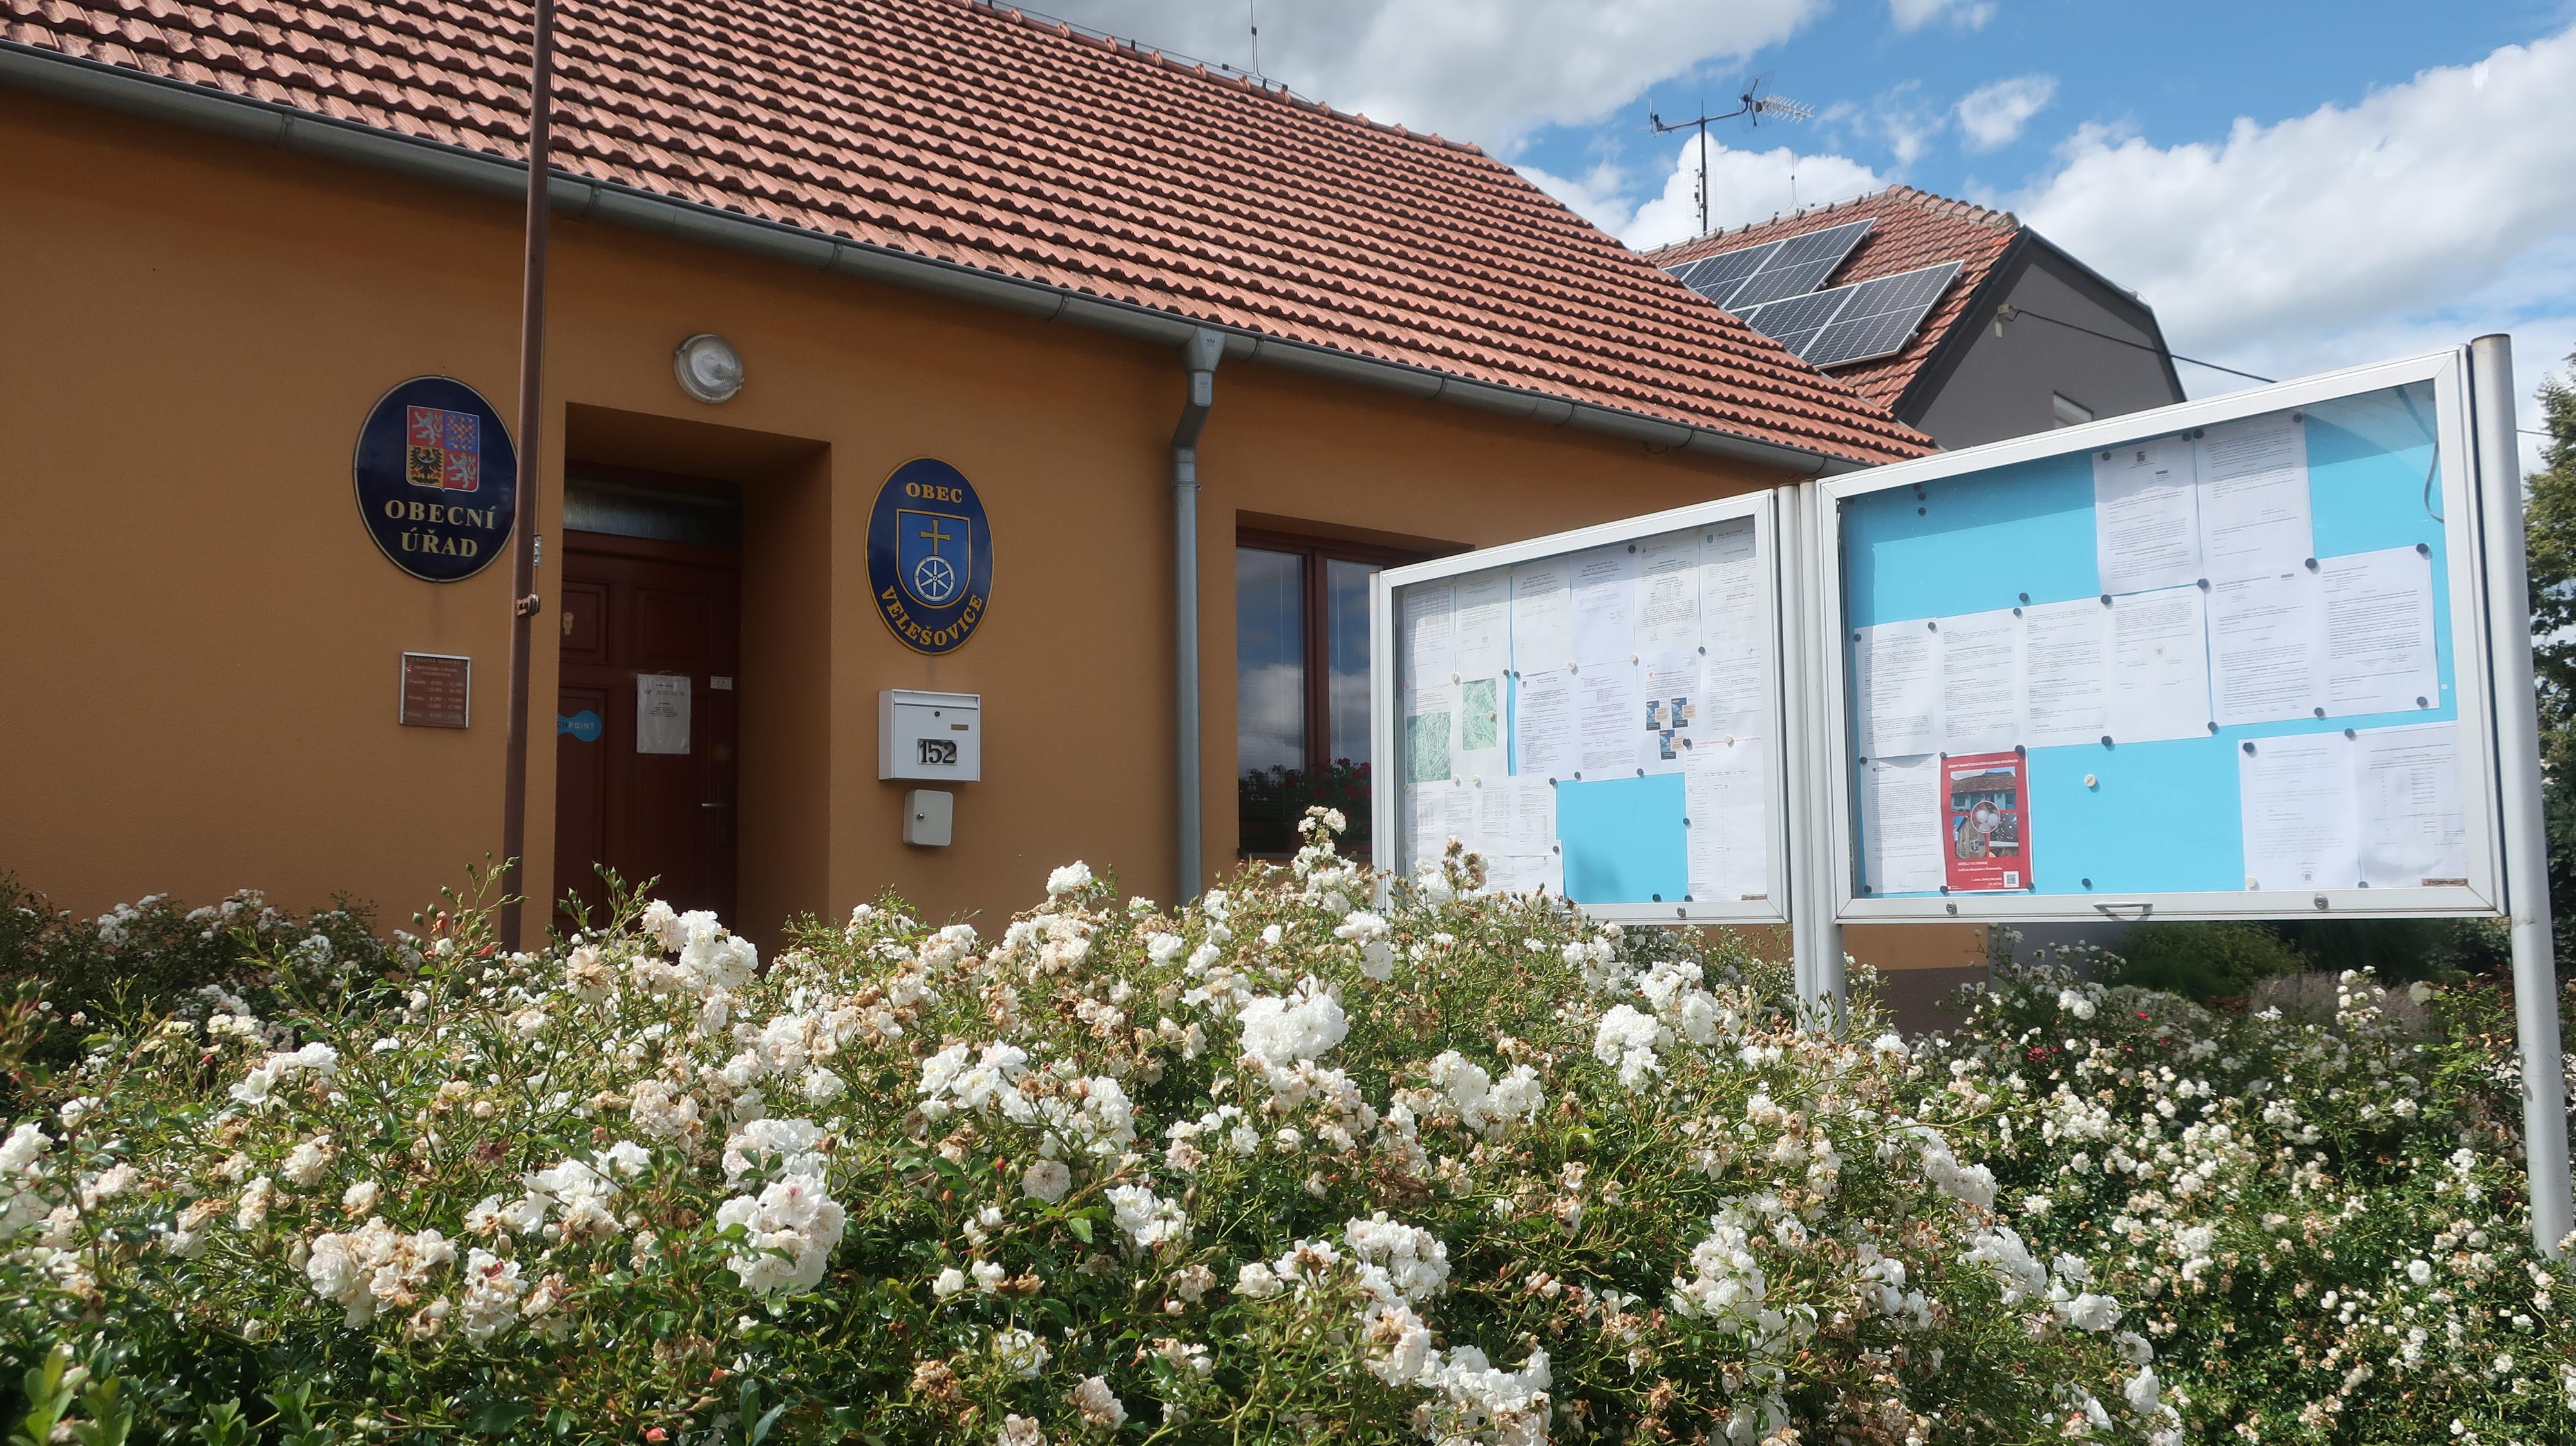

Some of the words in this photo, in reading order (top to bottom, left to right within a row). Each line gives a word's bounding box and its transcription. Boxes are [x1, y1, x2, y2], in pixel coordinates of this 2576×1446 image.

[905, 482, 963, 504] OBEC
[384, 499, 496, 529] OBECNÍ
[401, 526, 478, 557] ÚŘAD
[880, 585, 983, 646] VELEŠOVICE
[919, 740, 957, 764] 152
